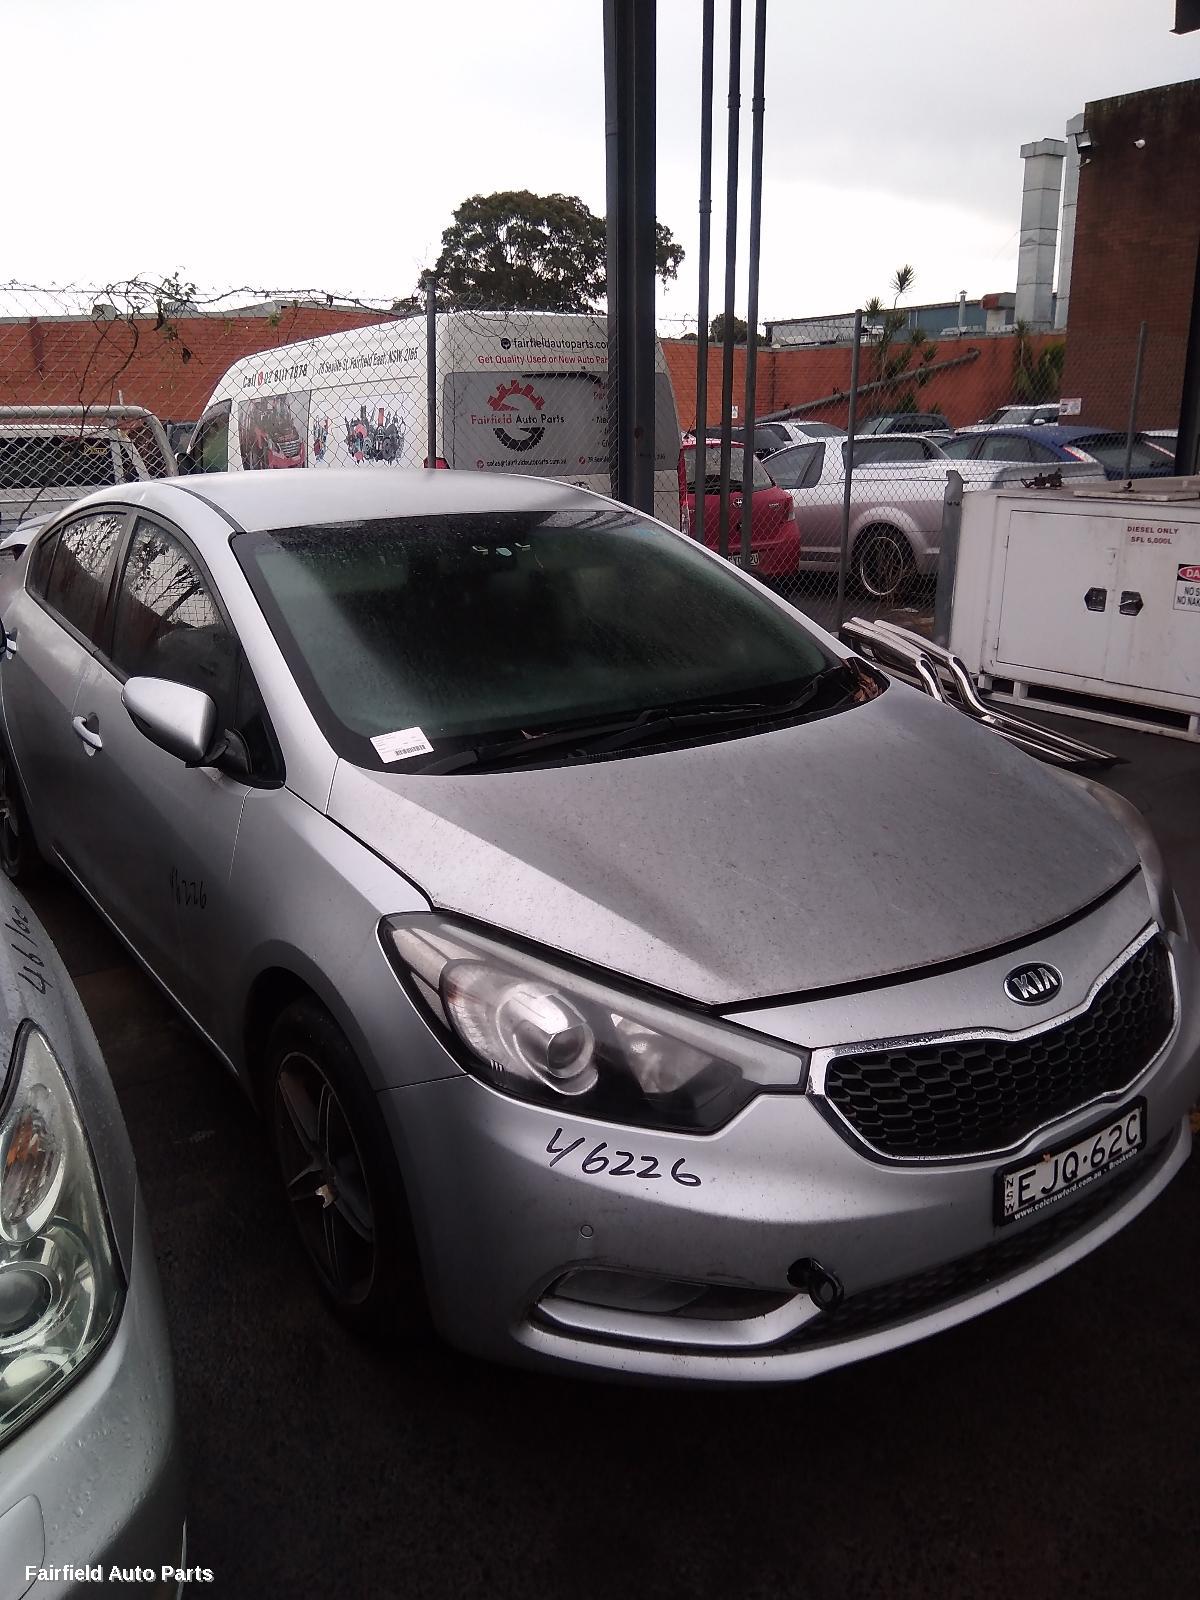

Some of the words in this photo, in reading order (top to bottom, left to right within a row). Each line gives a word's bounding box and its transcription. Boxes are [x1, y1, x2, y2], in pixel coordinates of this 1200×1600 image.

[350, 354, 373, 369] Fairfield
[478, 354, 493, 364] Get
[496, 354, 524, 365] Quality
[527, 354, 547, 364] Used
[549, 356, 557, 364] or
[559, 355, 576, 364] New
[577, 355, 594, 364] Auto
[596, 355, 608, 364] Par
[243, 374, 256, 389] Call
[471, 413, 513, 425] Fairfield
[516, 414, 538, 424] Auto
[540, 413, 565, 424] Parts
[1127, 526, 1154, 534] DIESEL
[1157, 527, 1179, 535] ONLY
[1186, 569, 1200, 578] DA
[1184, 587, 1194, 596] NO
[1176, 596, 1187, 605] NO
[1187, 597, 1200, 608] NAK
[1012, 966, 1059, 999] KIA
[546, 1128, 702, 1187] 46226
